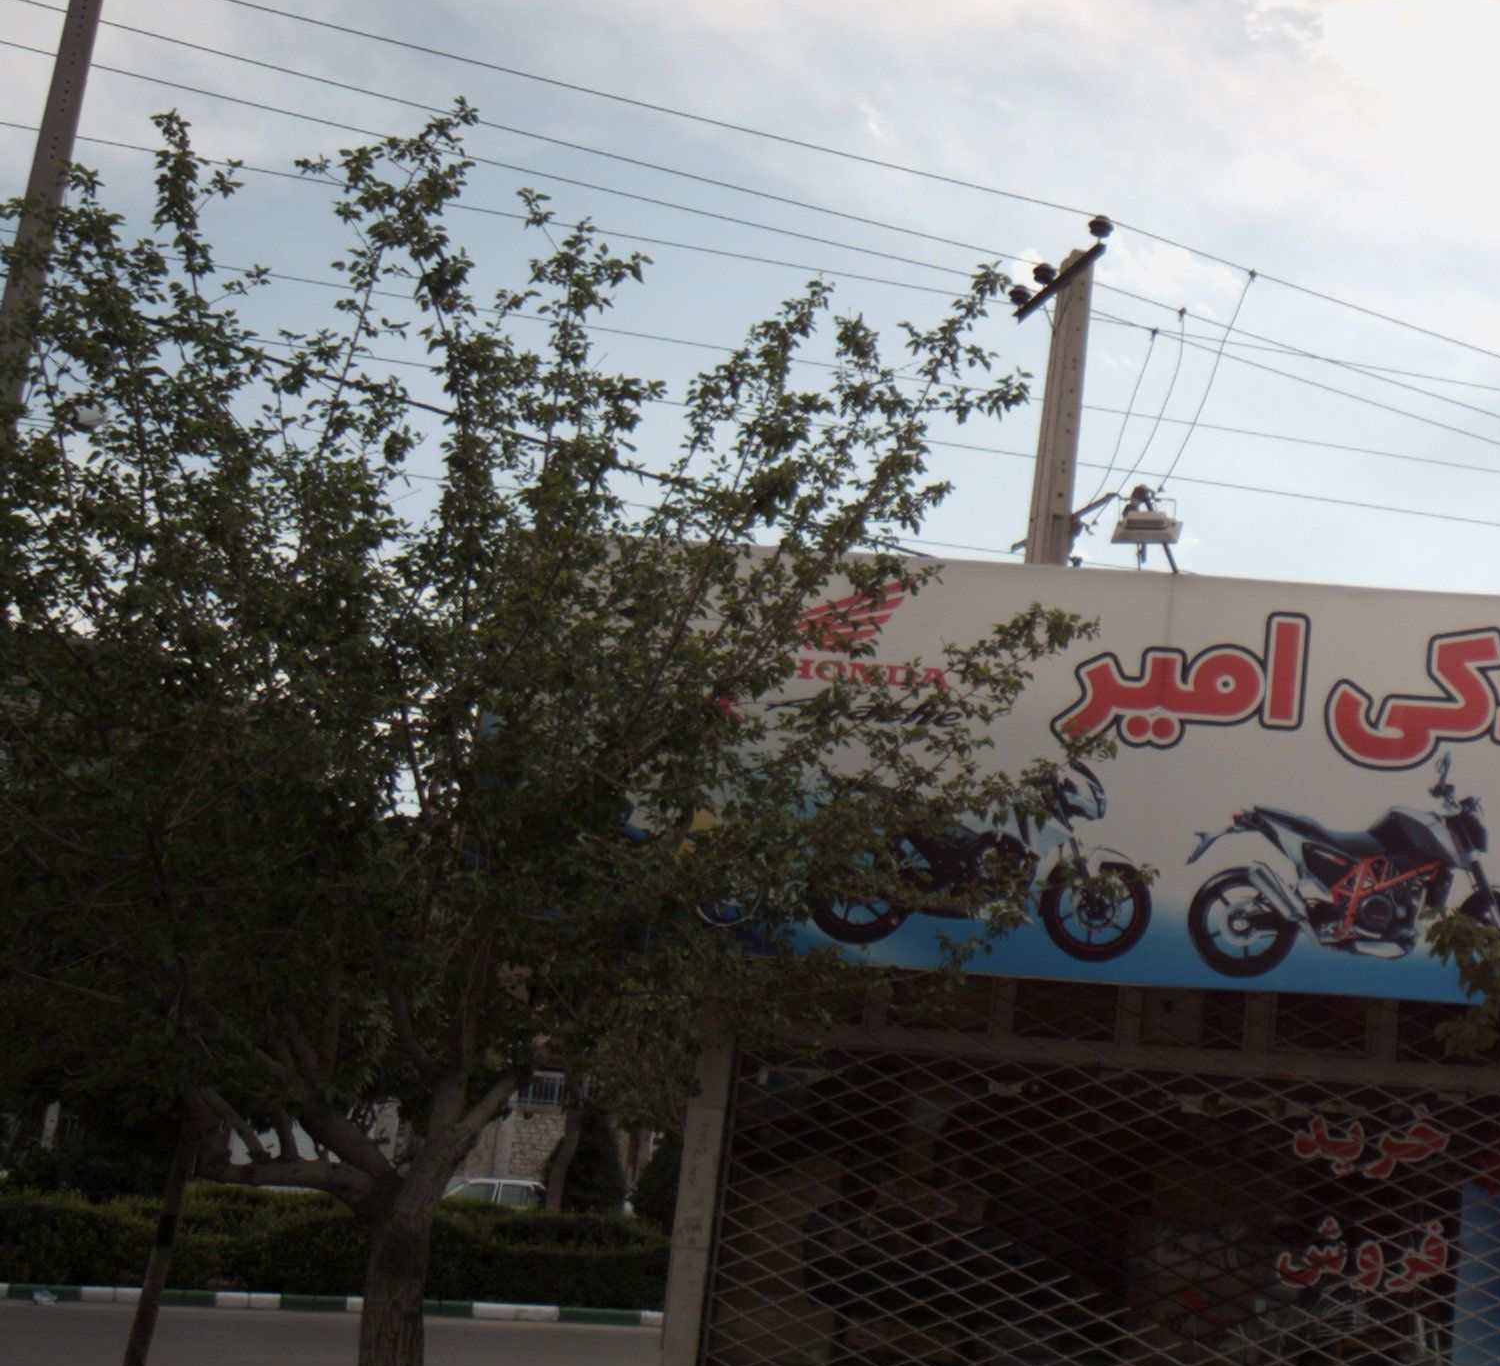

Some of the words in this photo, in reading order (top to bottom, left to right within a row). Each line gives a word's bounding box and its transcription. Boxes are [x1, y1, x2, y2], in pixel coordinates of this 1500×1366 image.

[1052, 612, 1310, 749] امیر
[1294, 1102, 1449, 1179] خرید
[1276, 1215, 1449, 1292] فروش
